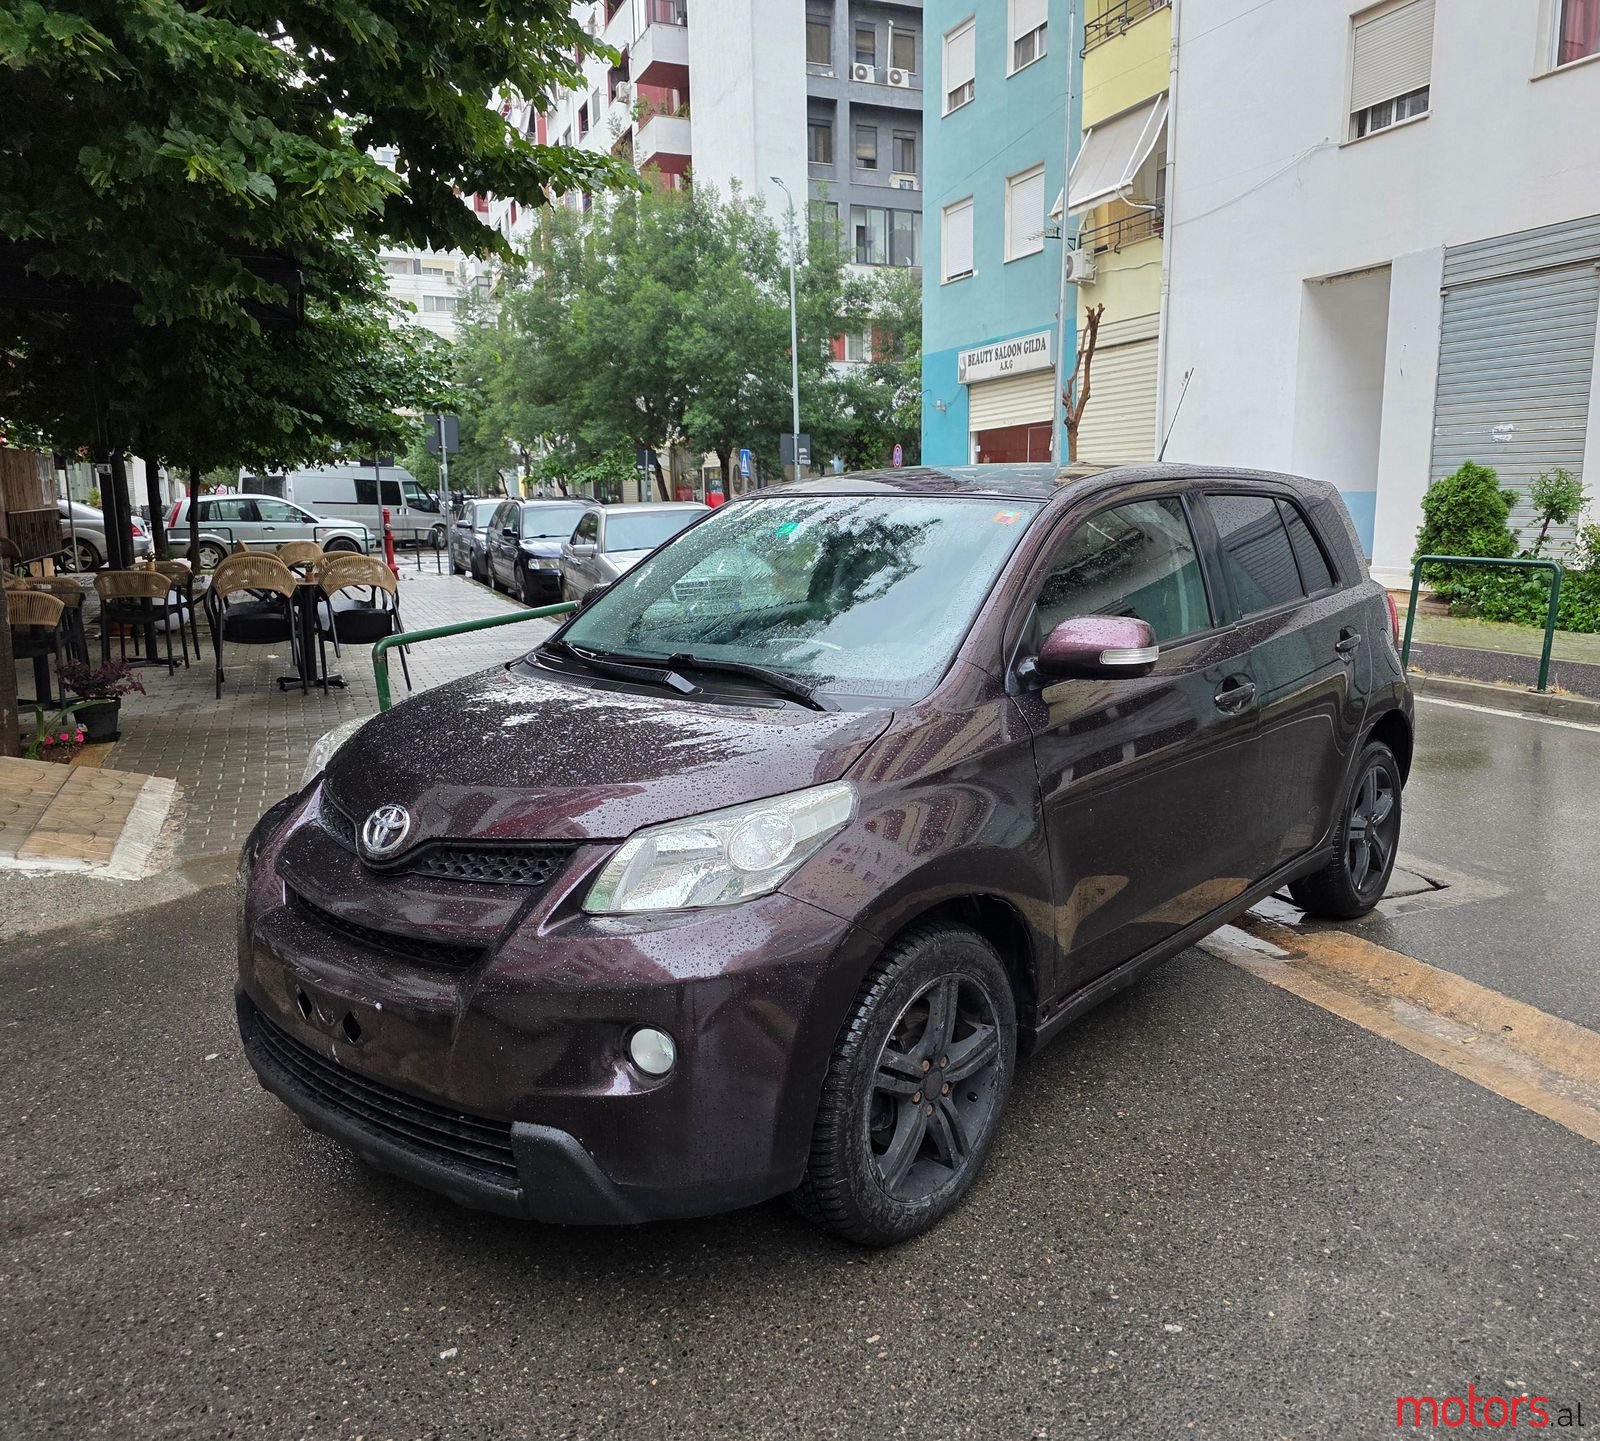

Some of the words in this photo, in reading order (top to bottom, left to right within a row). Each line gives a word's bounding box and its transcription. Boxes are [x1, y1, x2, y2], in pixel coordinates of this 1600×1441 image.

[968, 349, 993, 367] BEAUTY
[995, 342, 1022, 360] SALOON
[1024, 337, 1046, 354] GILDA
